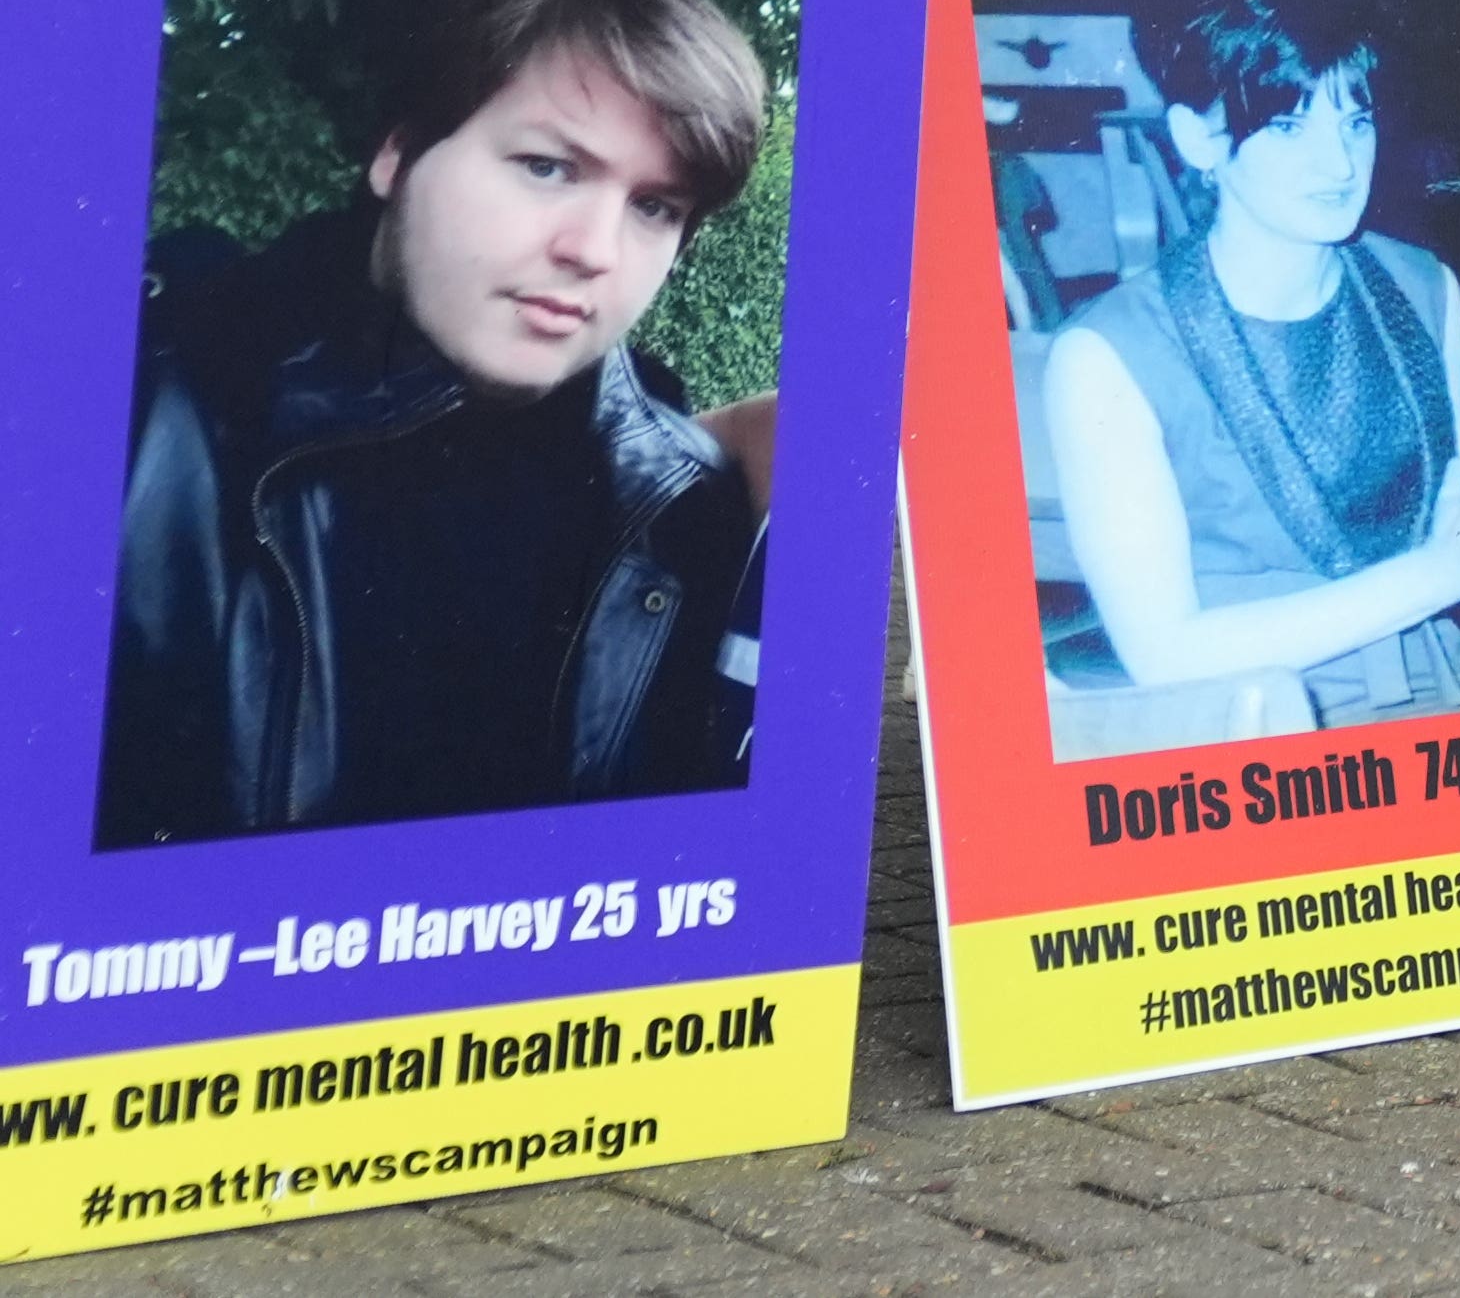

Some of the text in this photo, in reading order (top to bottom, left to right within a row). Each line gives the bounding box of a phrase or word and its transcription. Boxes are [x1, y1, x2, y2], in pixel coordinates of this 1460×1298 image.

[1084, 772, 1232, 846] Doris
[1241, 748, 1397, 825] Smith
[22, 933, 235, 1007] Tommy
[378, 896, 565, 964] Harvey
[569, 879, 638, 942] 25
[656, 878, 737, 938] yrs
